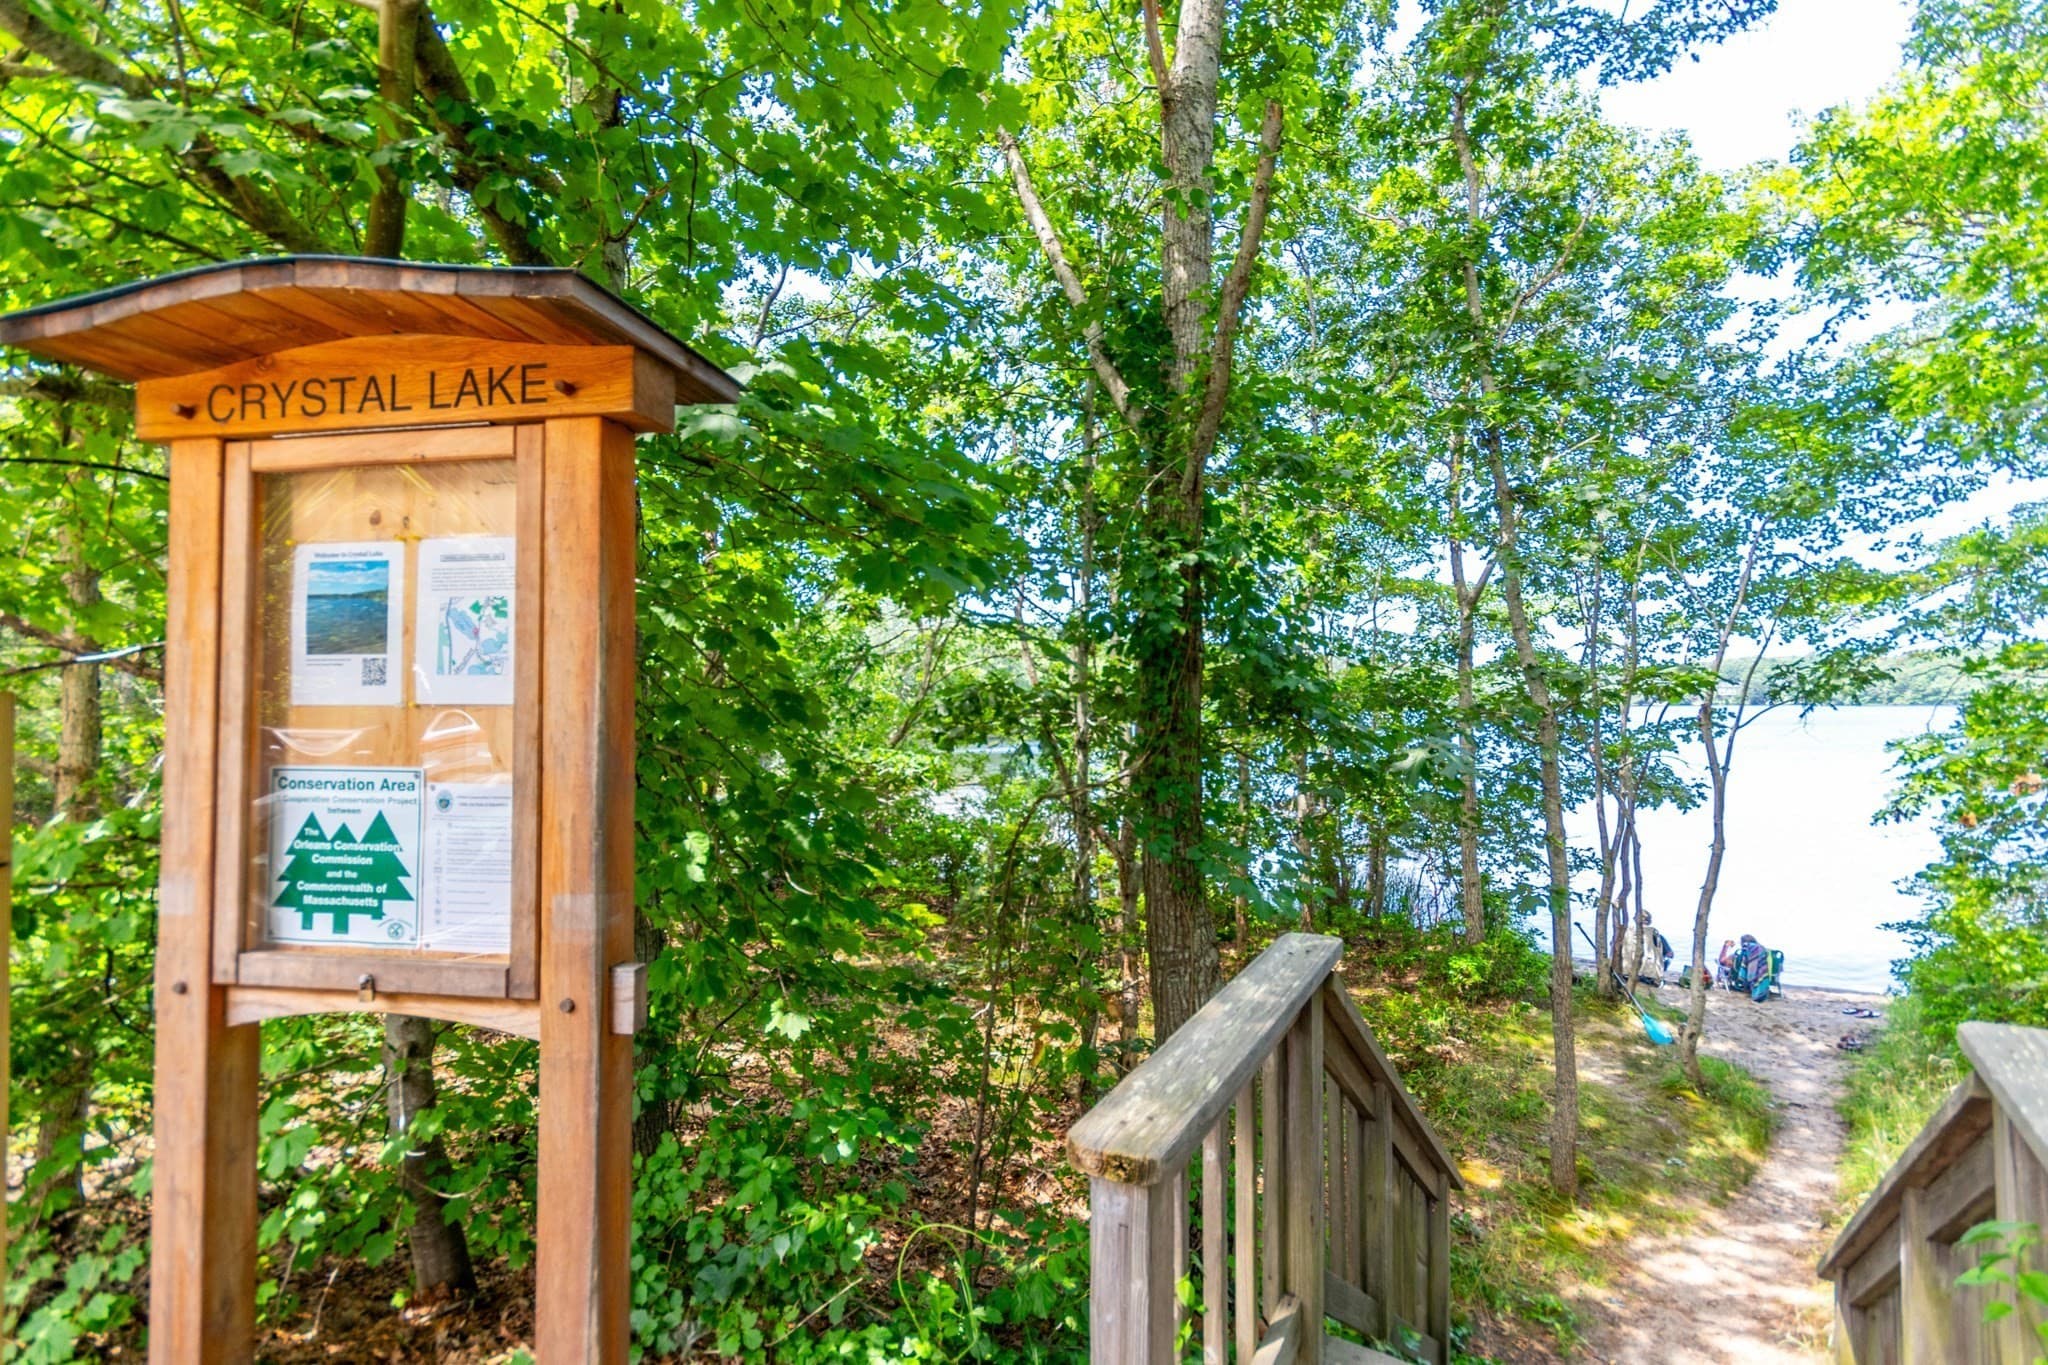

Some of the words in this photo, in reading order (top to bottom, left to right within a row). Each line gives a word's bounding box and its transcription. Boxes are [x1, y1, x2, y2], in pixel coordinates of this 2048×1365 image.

[207, 373, 411, 423] CRYSTAL
[430, 363, 548, 409] LAKE
[277, 775, 375, 791] Conservation
[380, 777, 416, 791] Area
[304, 828, 319, 836] The
[293, 840, 332, 850] Orleans
[333, 841, 402, 852] Conservation
[311, 854, 373, 865] Commission
[326, 870, 342, 878] and
[343, 870, 358, 879] the
[296, 880, 374, 893] Commonwealth
[375, 883, 388, 894] of
[303, 894, 378, 907] Massachusetts
